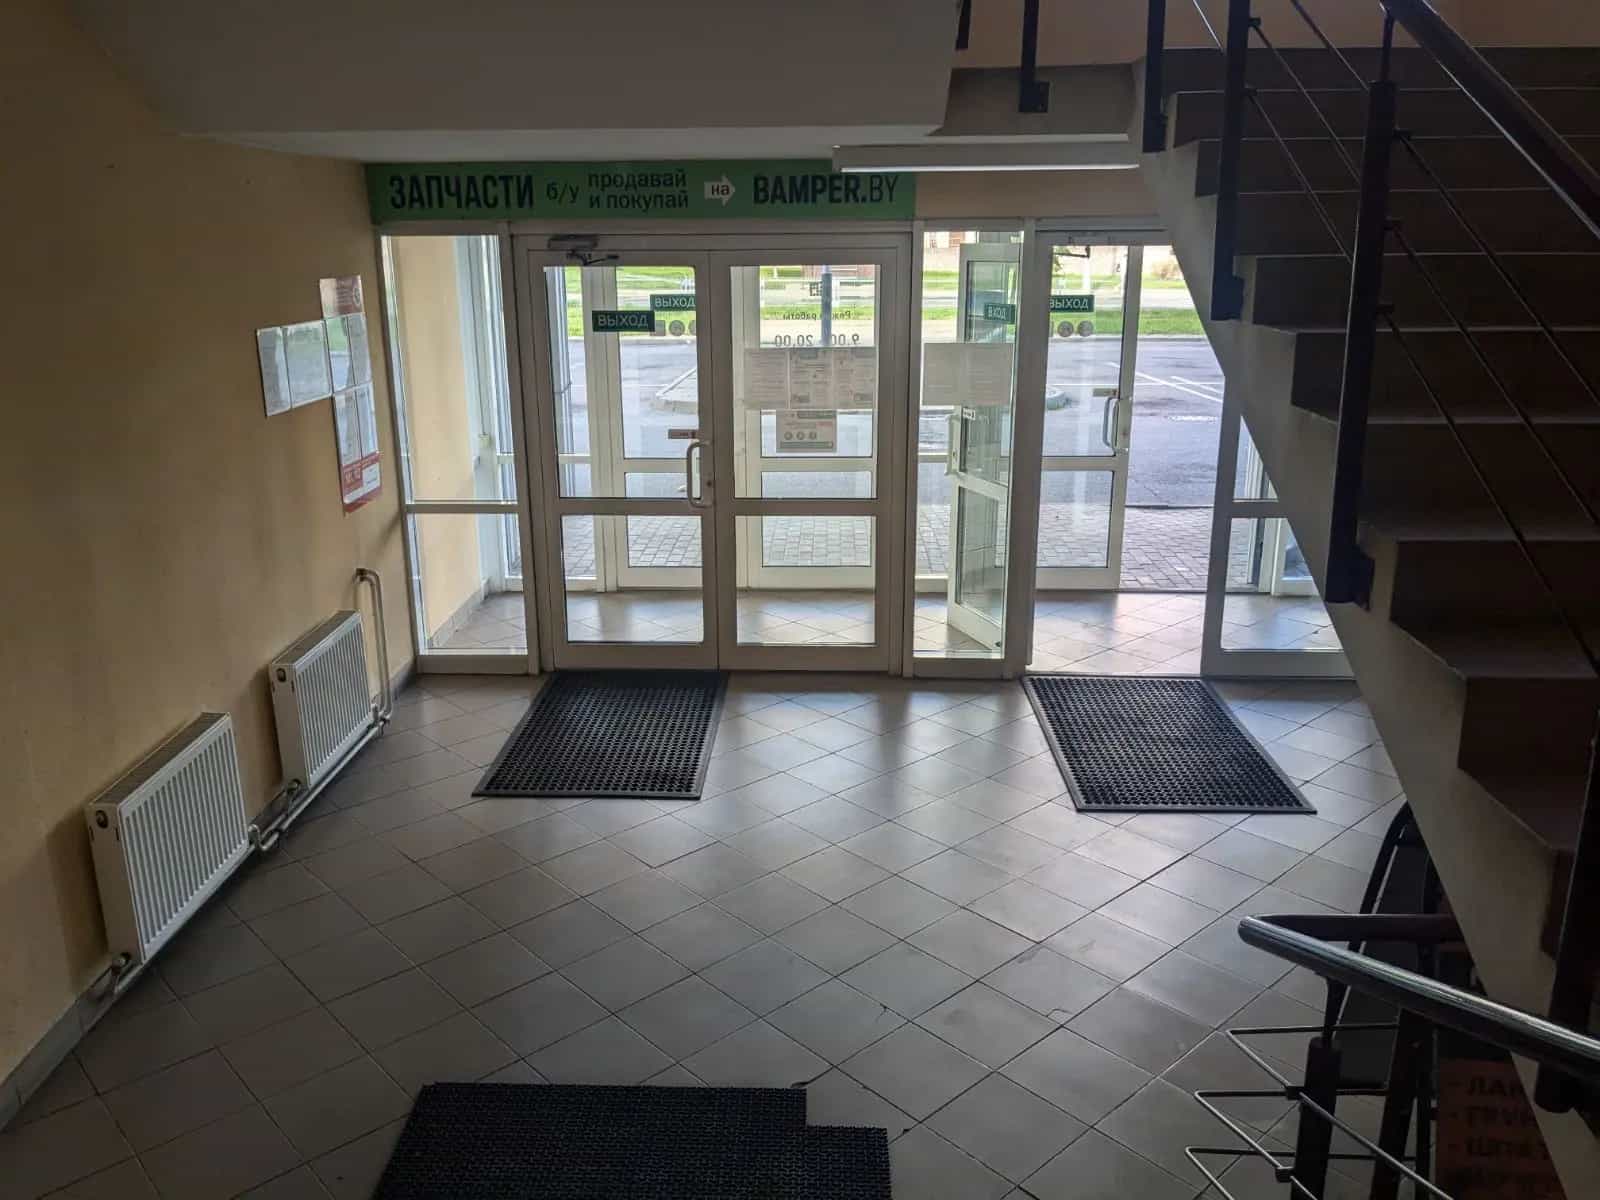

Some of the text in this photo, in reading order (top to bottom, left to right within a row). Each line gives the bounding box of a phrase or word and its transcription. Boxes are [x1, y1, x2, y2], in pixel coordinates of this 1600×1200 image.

[389, 174, 534, 210] ЗАПЧАСТИ
[587, 171, 687, 192] продавай
[711, 183, 730, 196] на
[753, 173, 898, 205] BAMPER.BY
[546, 181, 580, 204] б/у
[589, 190, 689, 212] и покупай
[655, 296, 696, 309] ВЫХОД
[1049, 298, 1088, 309] ВЫХОД
[597, 314, 648, 328] ВЫХОД
